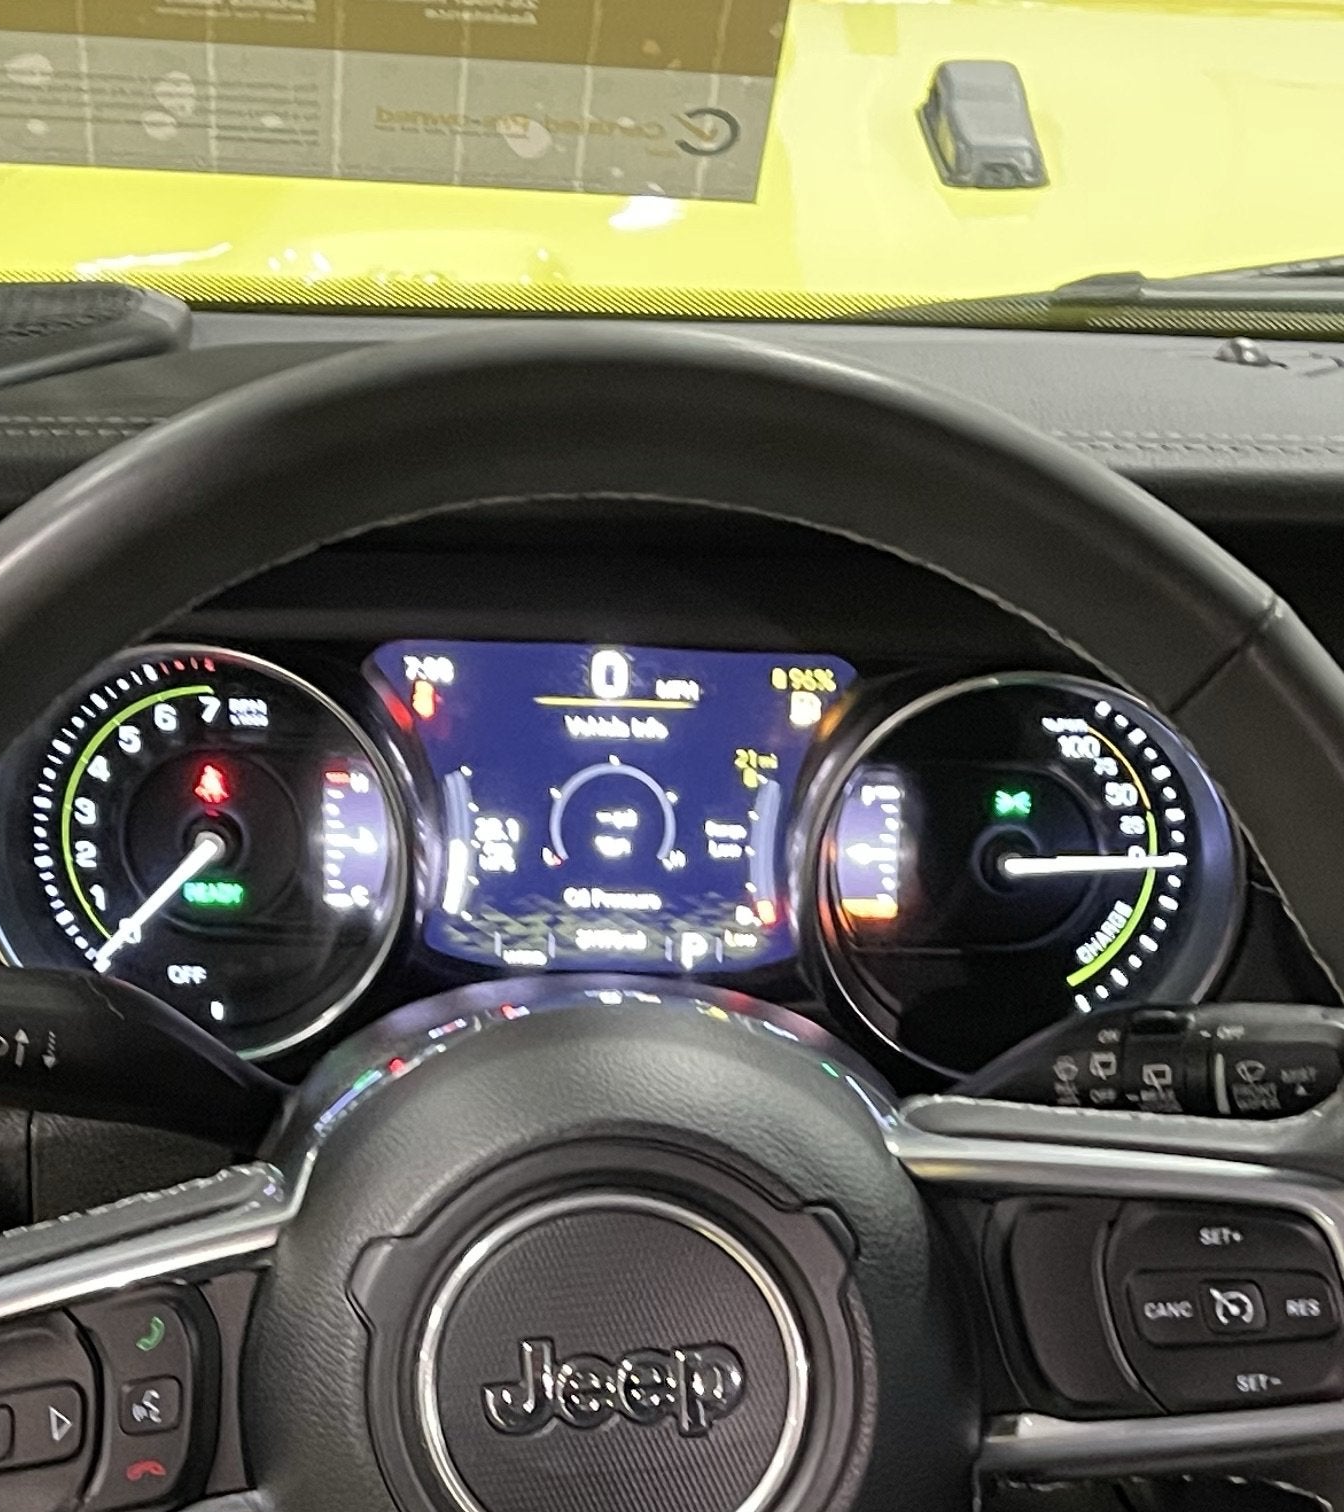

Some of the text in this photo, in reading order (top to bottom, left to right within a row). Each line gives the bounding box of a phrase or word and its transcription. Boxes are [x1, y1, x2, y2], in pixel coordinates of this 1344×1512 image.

[591, 650, 629, 700] 0
[154, 702, 178, 730] 6
[198, 696, 221, 723] 7
[118, 725, 143, 754] 5
[1057, 737, 1100, 760] 100
[87, 755, 111, 783] 4
[1104, 784, 1137, 808] 50
[73, 797, 98, 826] 3
[74, 840, 98, 869] 2
[89, 884, 107, 911] 1
[563, 887, 663, 912] Oil Pressure
[681, 932, 708, 972] P
[167, 965, 208, 986] OFF
[1143, 1300, 1194, 1320] CANC
[1285, 1298, 1322, 1317] RES
[480, 1335, 747, 1438] Jeep
